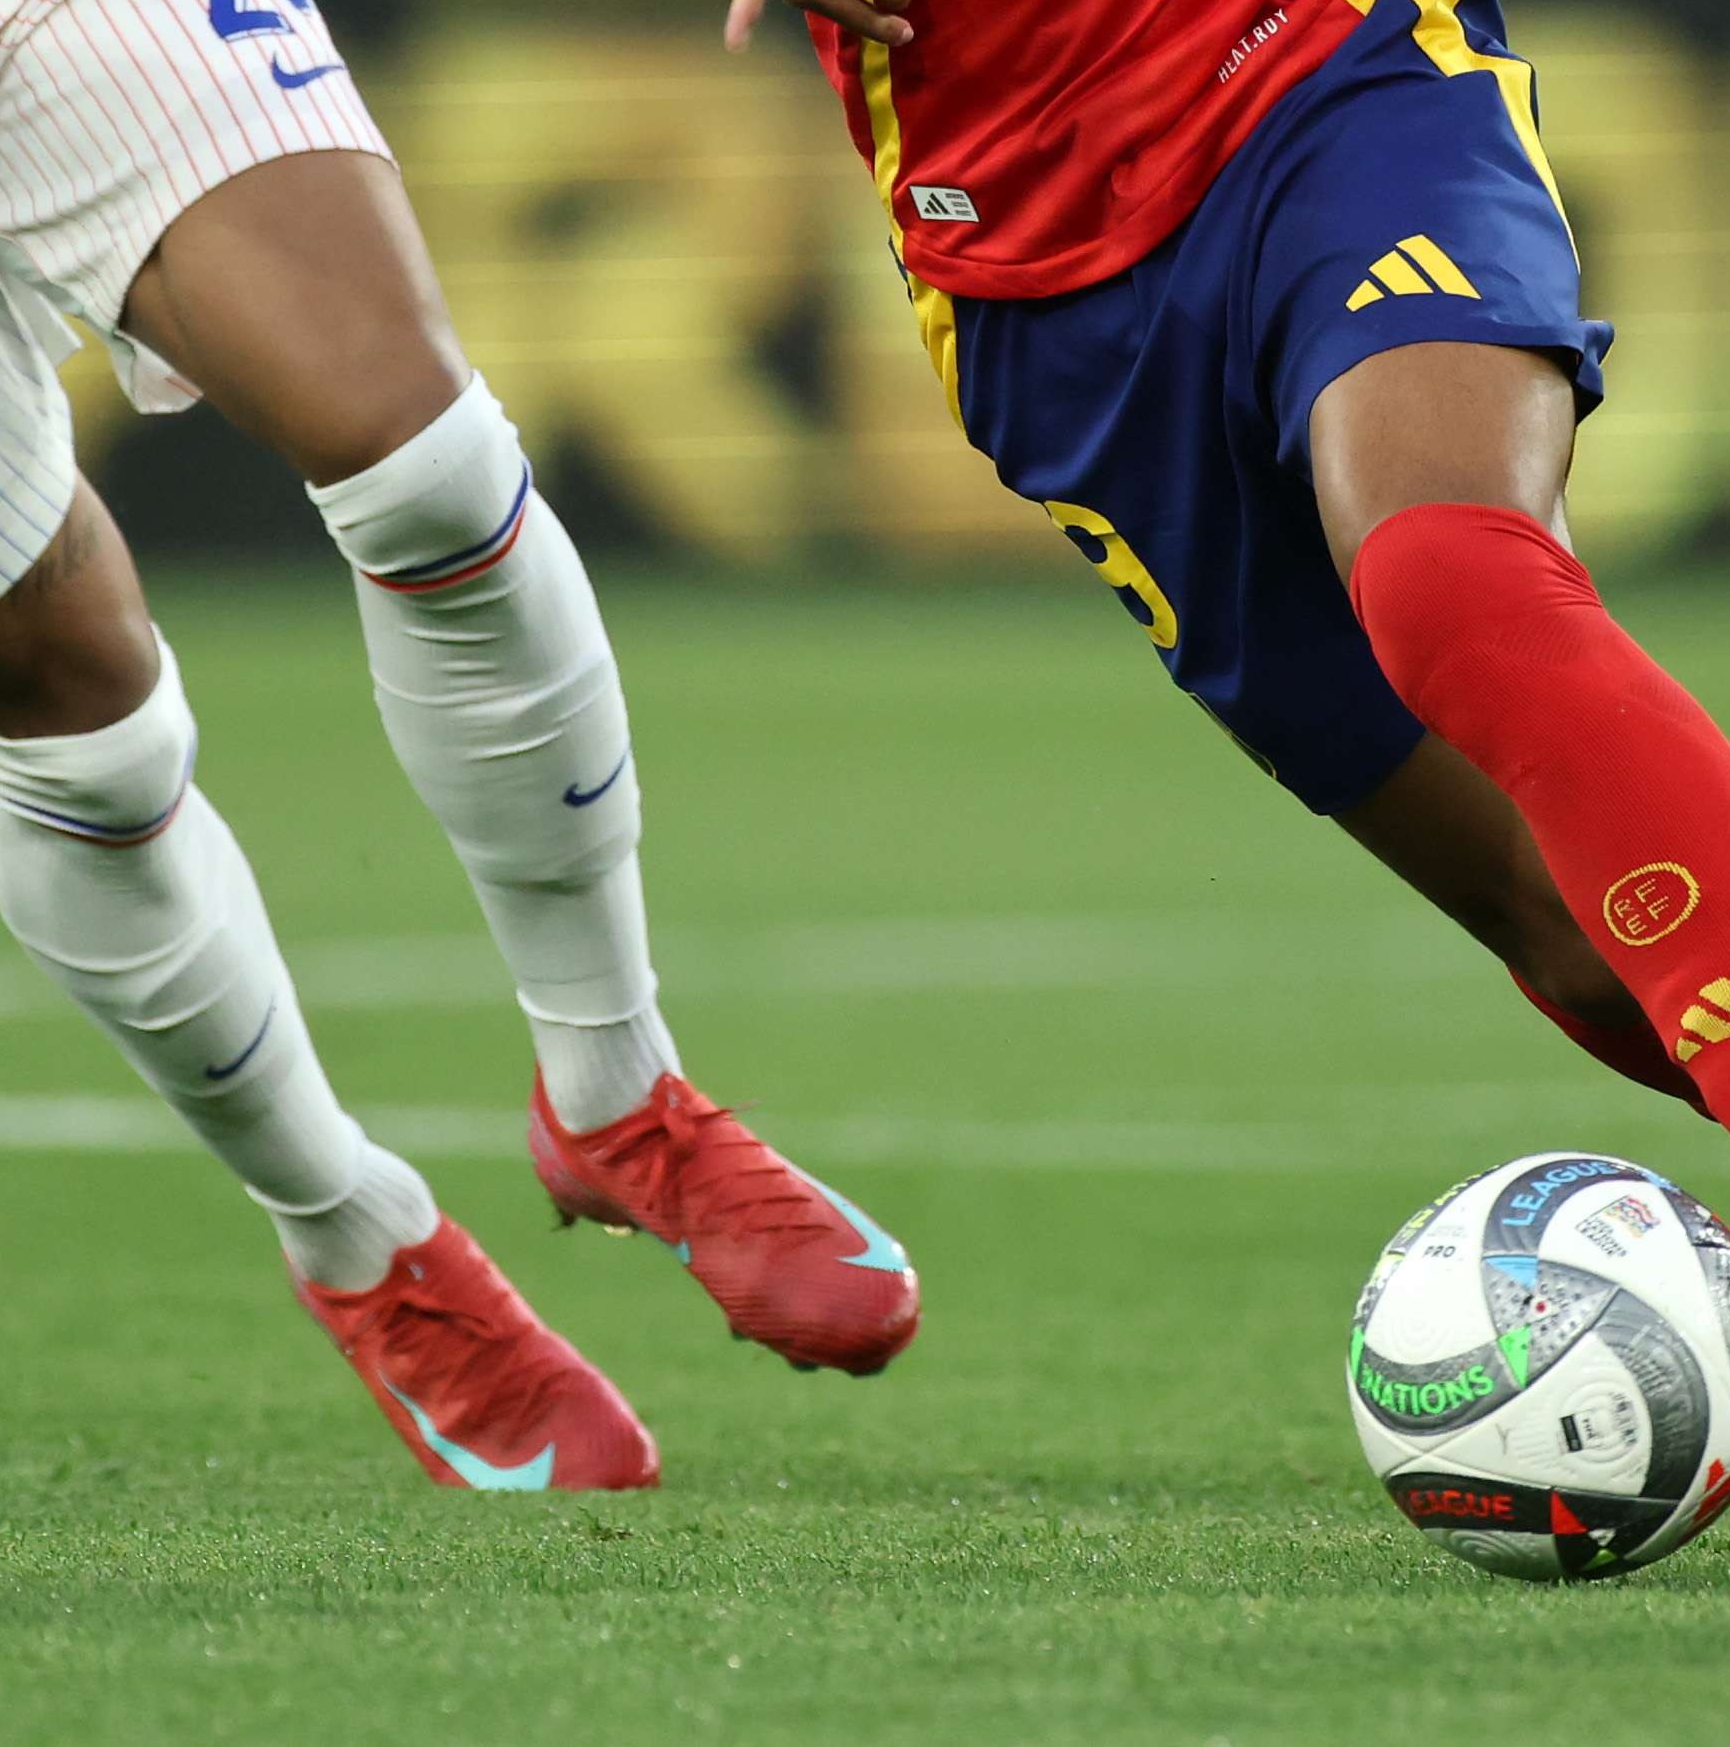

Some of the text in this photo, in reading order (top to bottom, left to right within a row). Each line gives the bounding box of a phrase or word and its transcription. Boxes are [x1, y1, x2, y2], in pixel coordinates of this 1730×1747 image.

[1501, 1161, 1620, 1227] LEAGUE
[1423, 1245, 1457, 1259] PRO
[1359, 1362, 1495, 1417] NATIONS
[1404, 1487, 1517, 1522] EAGUE
